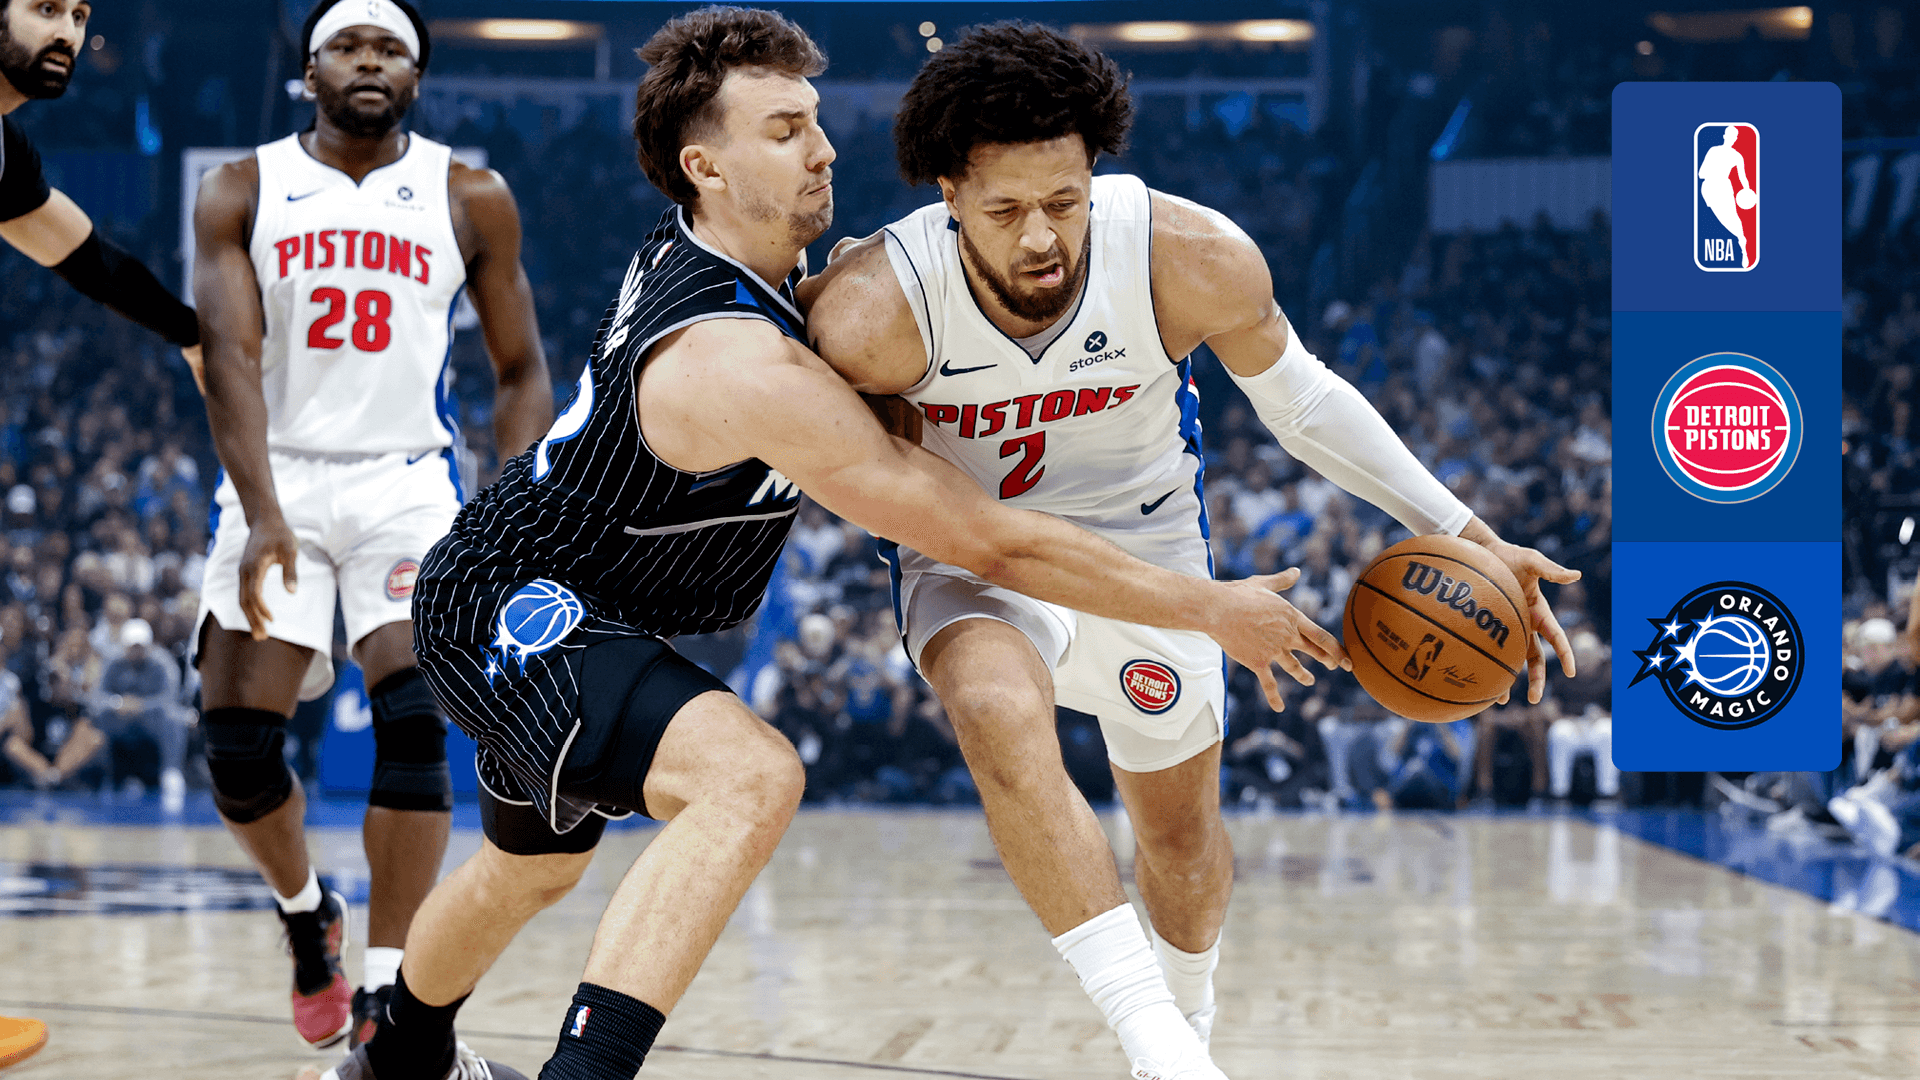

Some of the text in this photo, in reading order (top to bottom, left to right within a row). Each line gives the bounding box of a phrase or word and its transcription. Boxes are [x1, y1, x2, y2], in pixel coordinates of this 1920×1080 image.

[274, 229, 432, 286] PISTONS
[307, 286, 392, 353] 28
[917, 383, 1142, 439] PISTONS
[999, 430, 1046, 500] 2
[1401, 560, 1510, 650] Wilson
[1130, 679, 1168, 701] PISTONS
[1132, 670, 1170, 692] DETROIT
